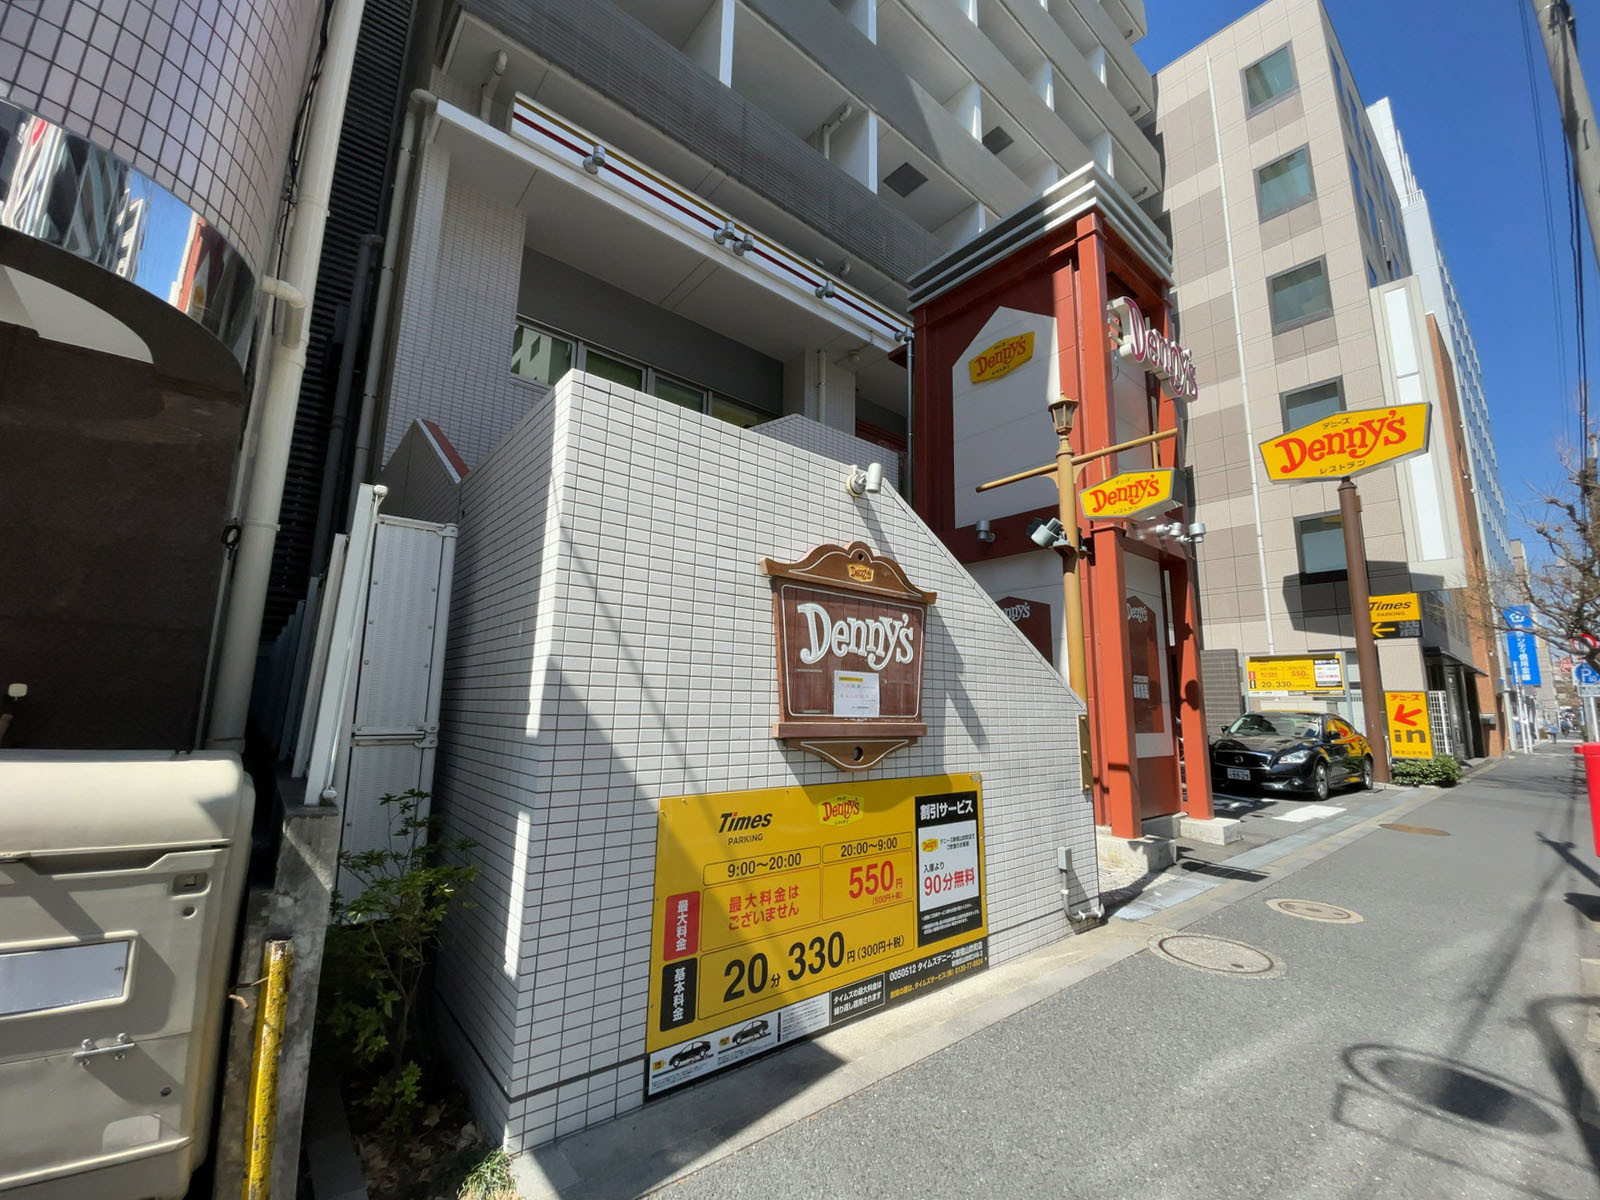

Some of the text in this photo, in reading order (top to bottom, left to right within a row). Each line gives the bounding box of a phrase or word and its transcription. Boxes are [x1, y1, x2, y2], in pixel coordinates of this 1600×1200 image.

[976, 336, 1026, 377] Denny's
[1113, 296, 1198, 402] Denny's
[1322, 416, 1352, 430] デニーズ
[1275, 410, 1407, 474] Denny's
[1320, 459, 1367, 475] レストラン
[1089, 474, 1160, 513] Denny's
[1369, 601, 1412, 611] Times
[797, 602, 914, 671] Denny's
[1394, 730, 1426, 743] in
[718, 811, 773, 834] Times
[822, 797, 860, 822] Denny's
[919, 800, 974, 821] 割引サービス
[727, 833, 764, 846] PARKING
[924, 867, 975, 897] 90分無料
[728, 884, 799, 913] 最大料金は
[675, 900, 689, 952] 最大料金
[728, 902, 799, 931] ございません
[672, 967, 686, 1022] 基本料金
